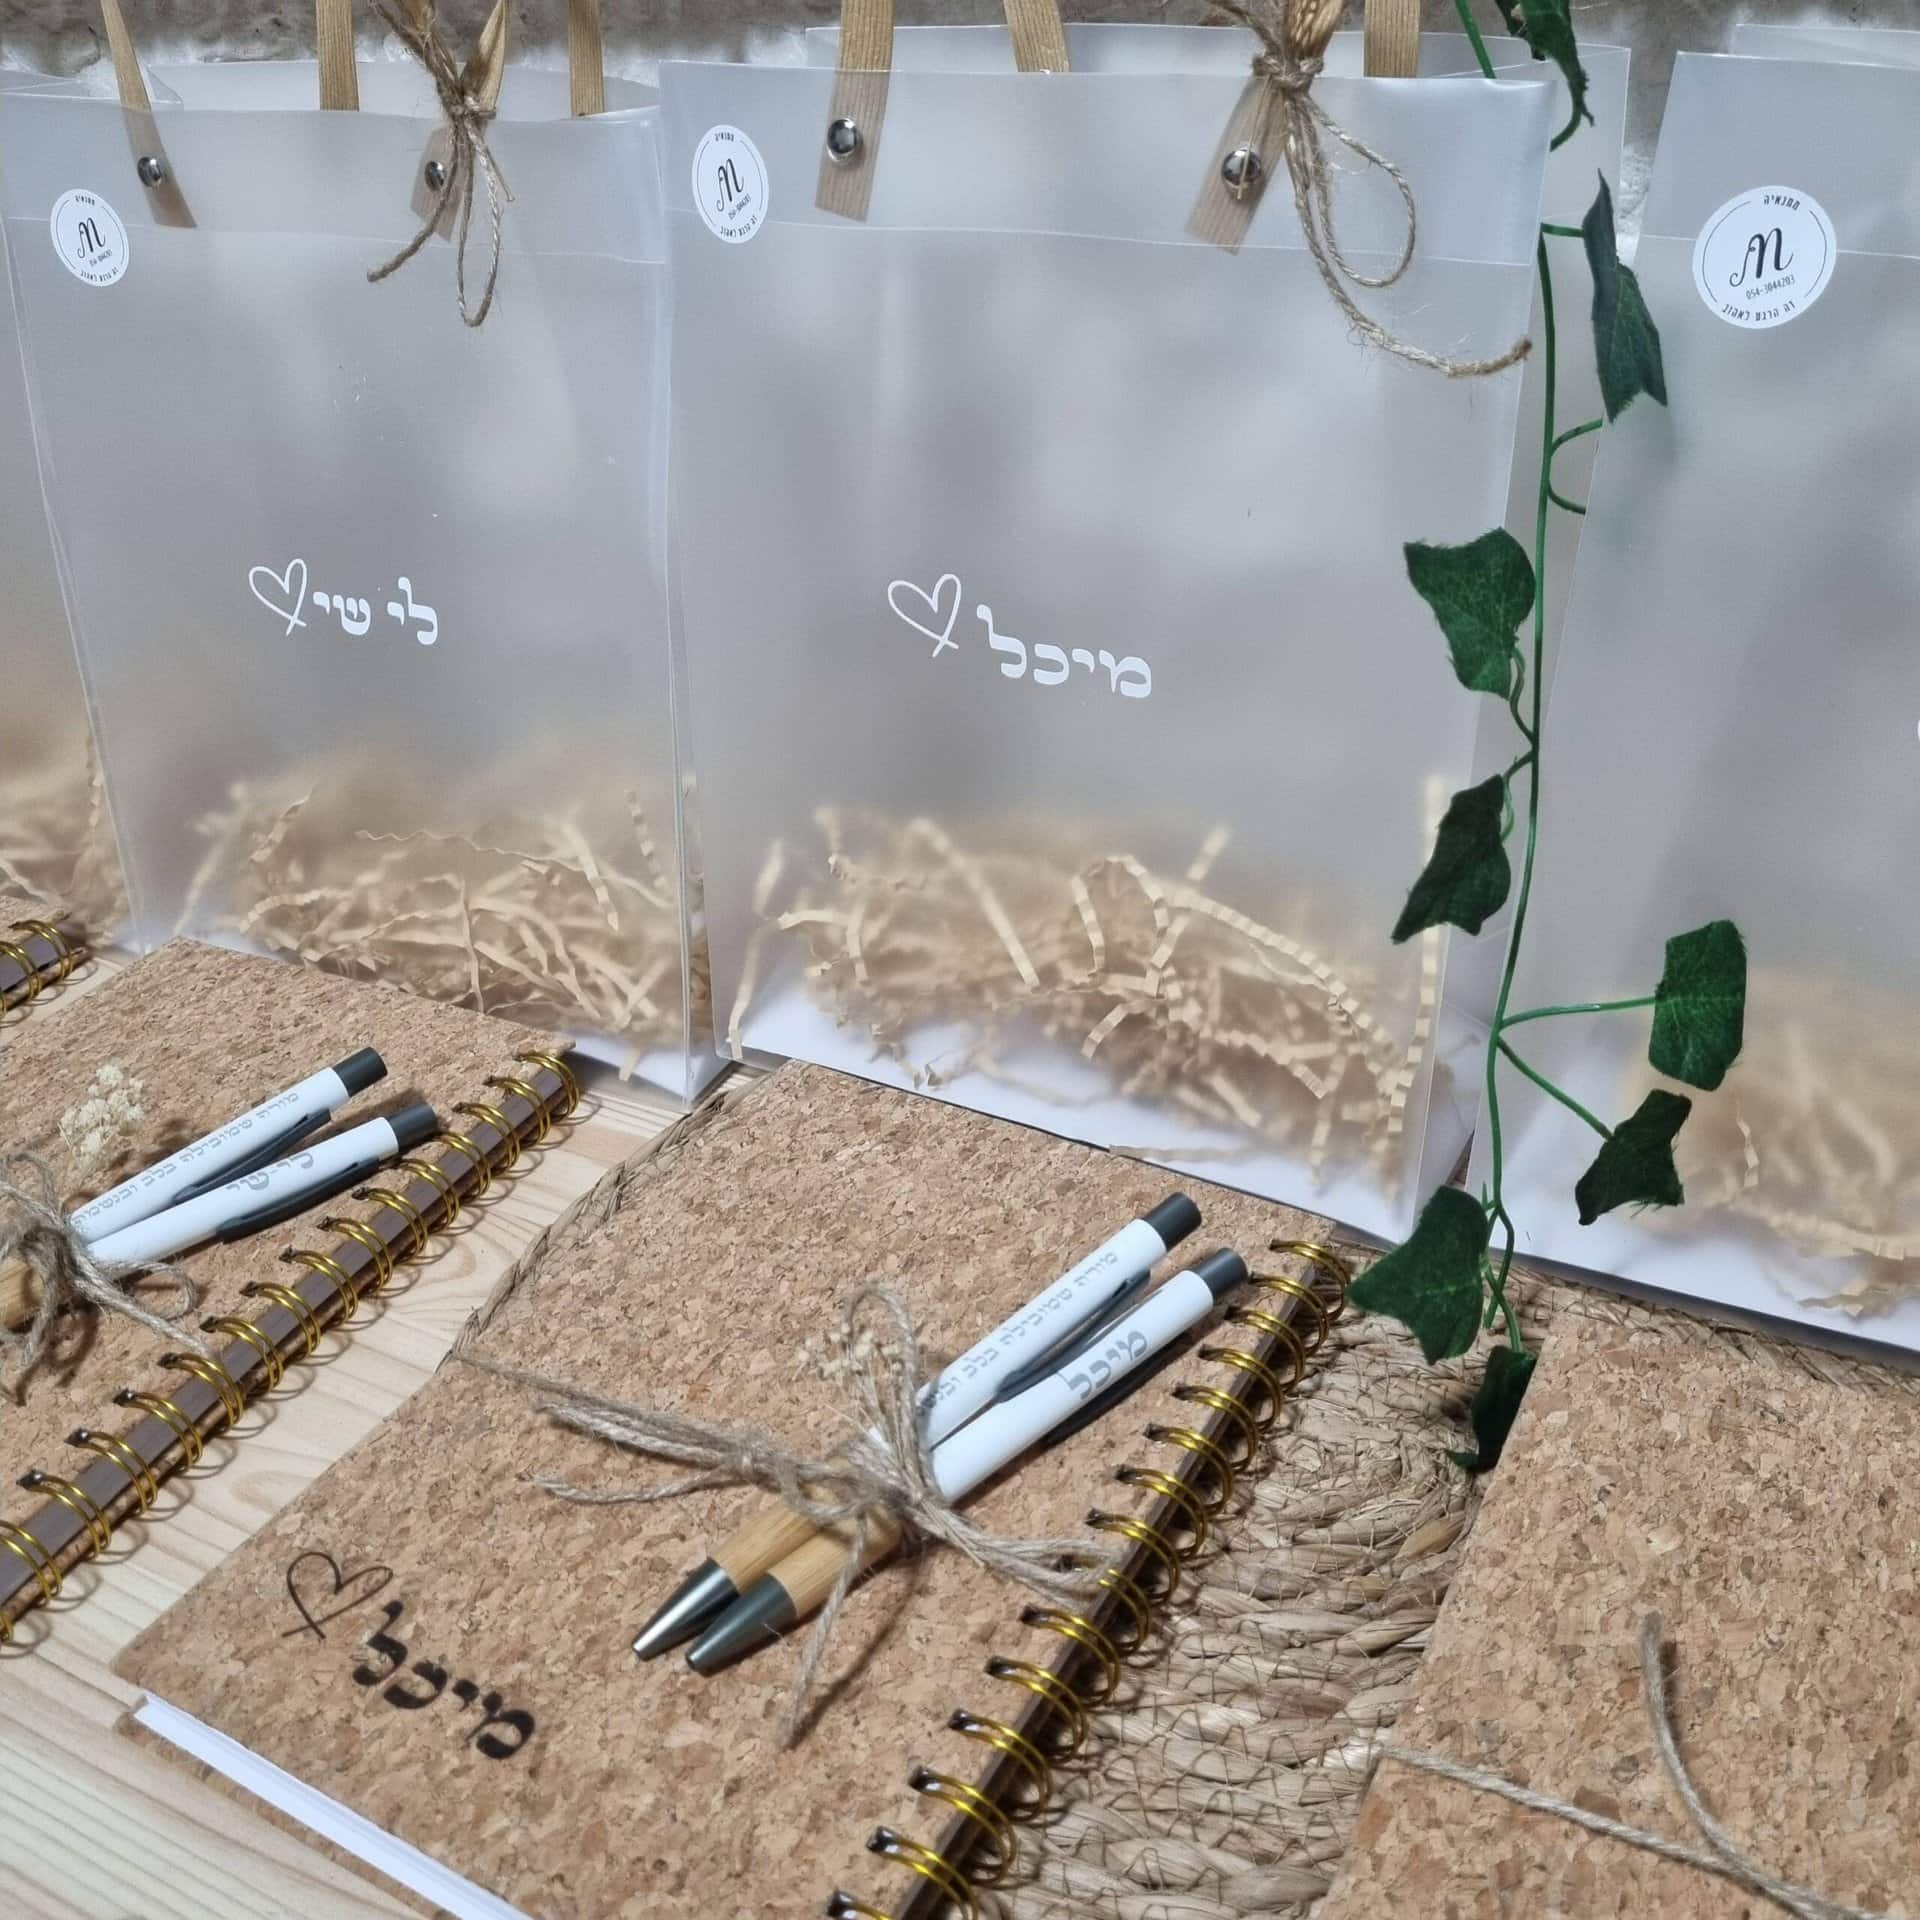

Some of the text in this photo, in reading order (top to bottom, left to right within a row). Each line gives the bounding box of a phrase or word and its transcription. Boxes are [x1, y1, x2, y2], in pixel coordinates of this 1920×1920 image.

[313, 576, 438, 645] לי שי
[976, 604, 1152, 698] מיכל
[255, 1091, 300, 1120] מורה
[178, 1118, 254, 1163] שמובילה
[1072, 1250, 1120, 1288] מורה
[1056, 1330, 1149, 1401] מיכל
[352, 1599, 536, 1761] מיכל
